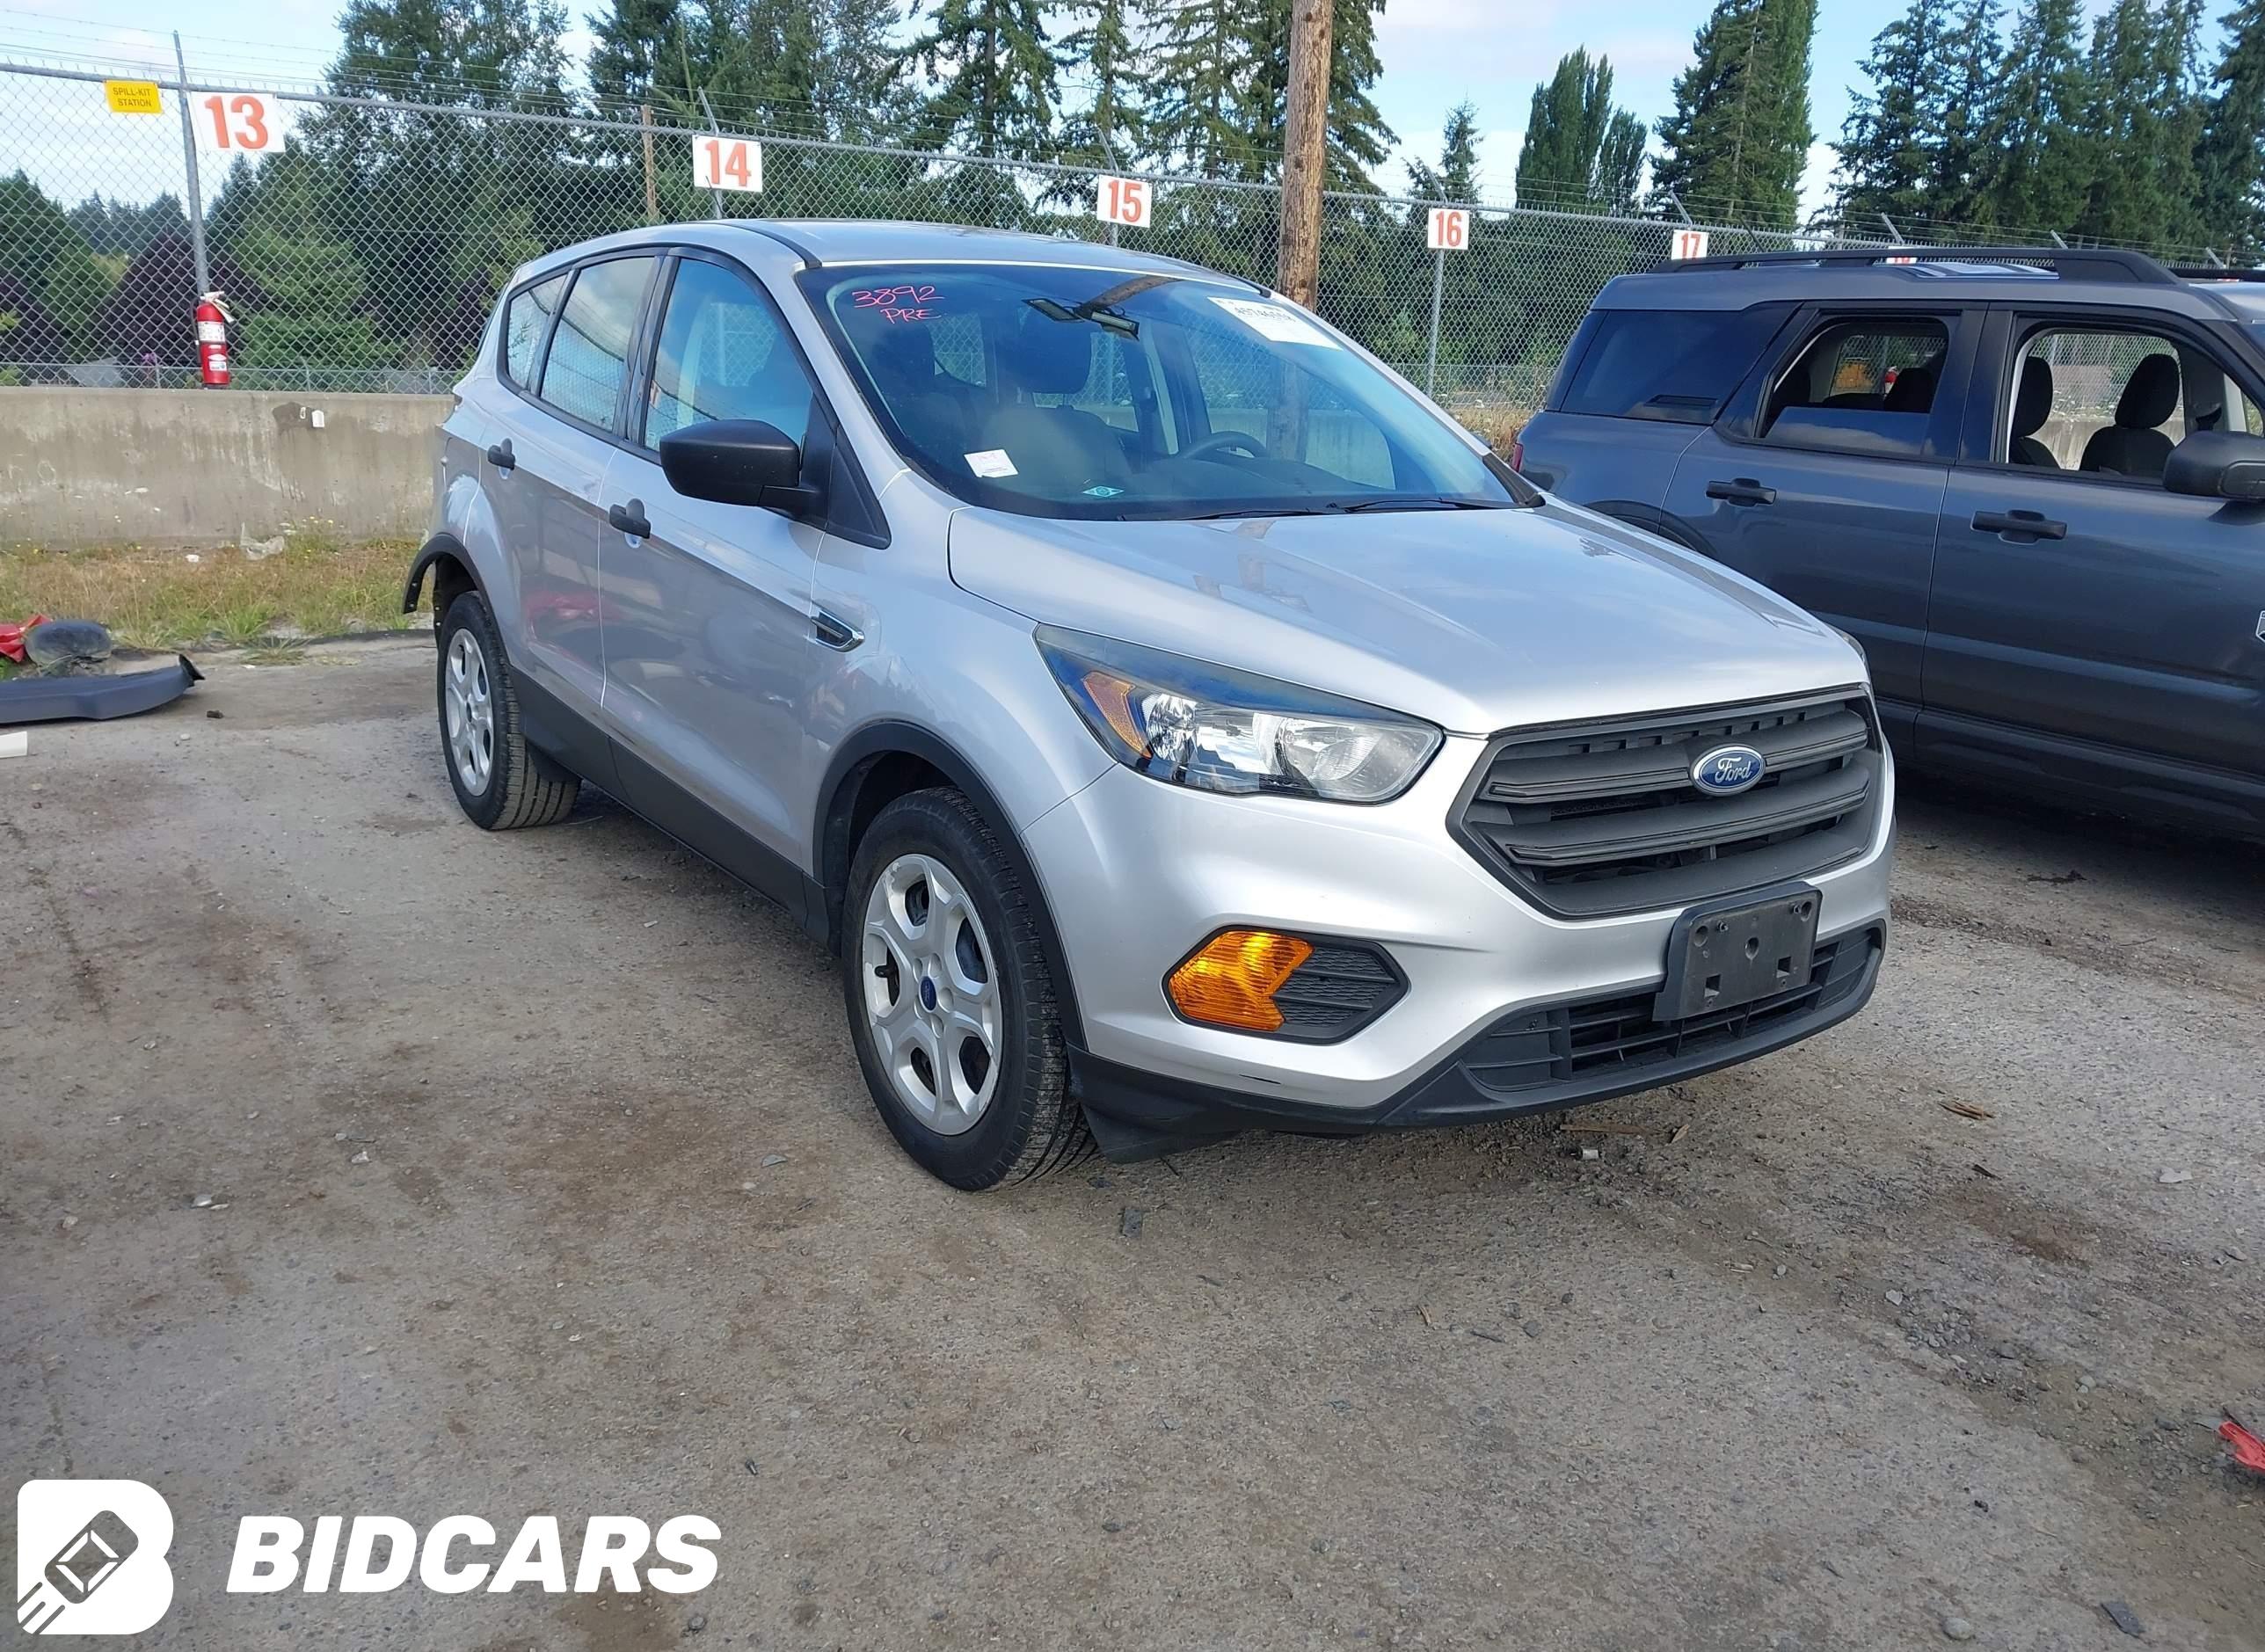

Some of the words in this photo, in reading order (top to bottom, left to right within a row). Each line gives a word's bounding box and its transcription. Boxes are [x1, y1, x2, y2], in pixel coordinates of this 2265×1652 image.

[113, 87, 151, 96] SPILL-KIT
[118, 98, 152, 106] STATION
[204, 95, 268, 149] 13
[705, 140, 752, 186] 14
[1108, 180, 1141, 222] 15
[1436, 211, 1461, 246] 16
[1681, 233, 1701, 259] 17
[851, 286, 945, 309] 3892
[880, 308, 942, 324] PRE
[1715, 757, 1752, 783] Ford
